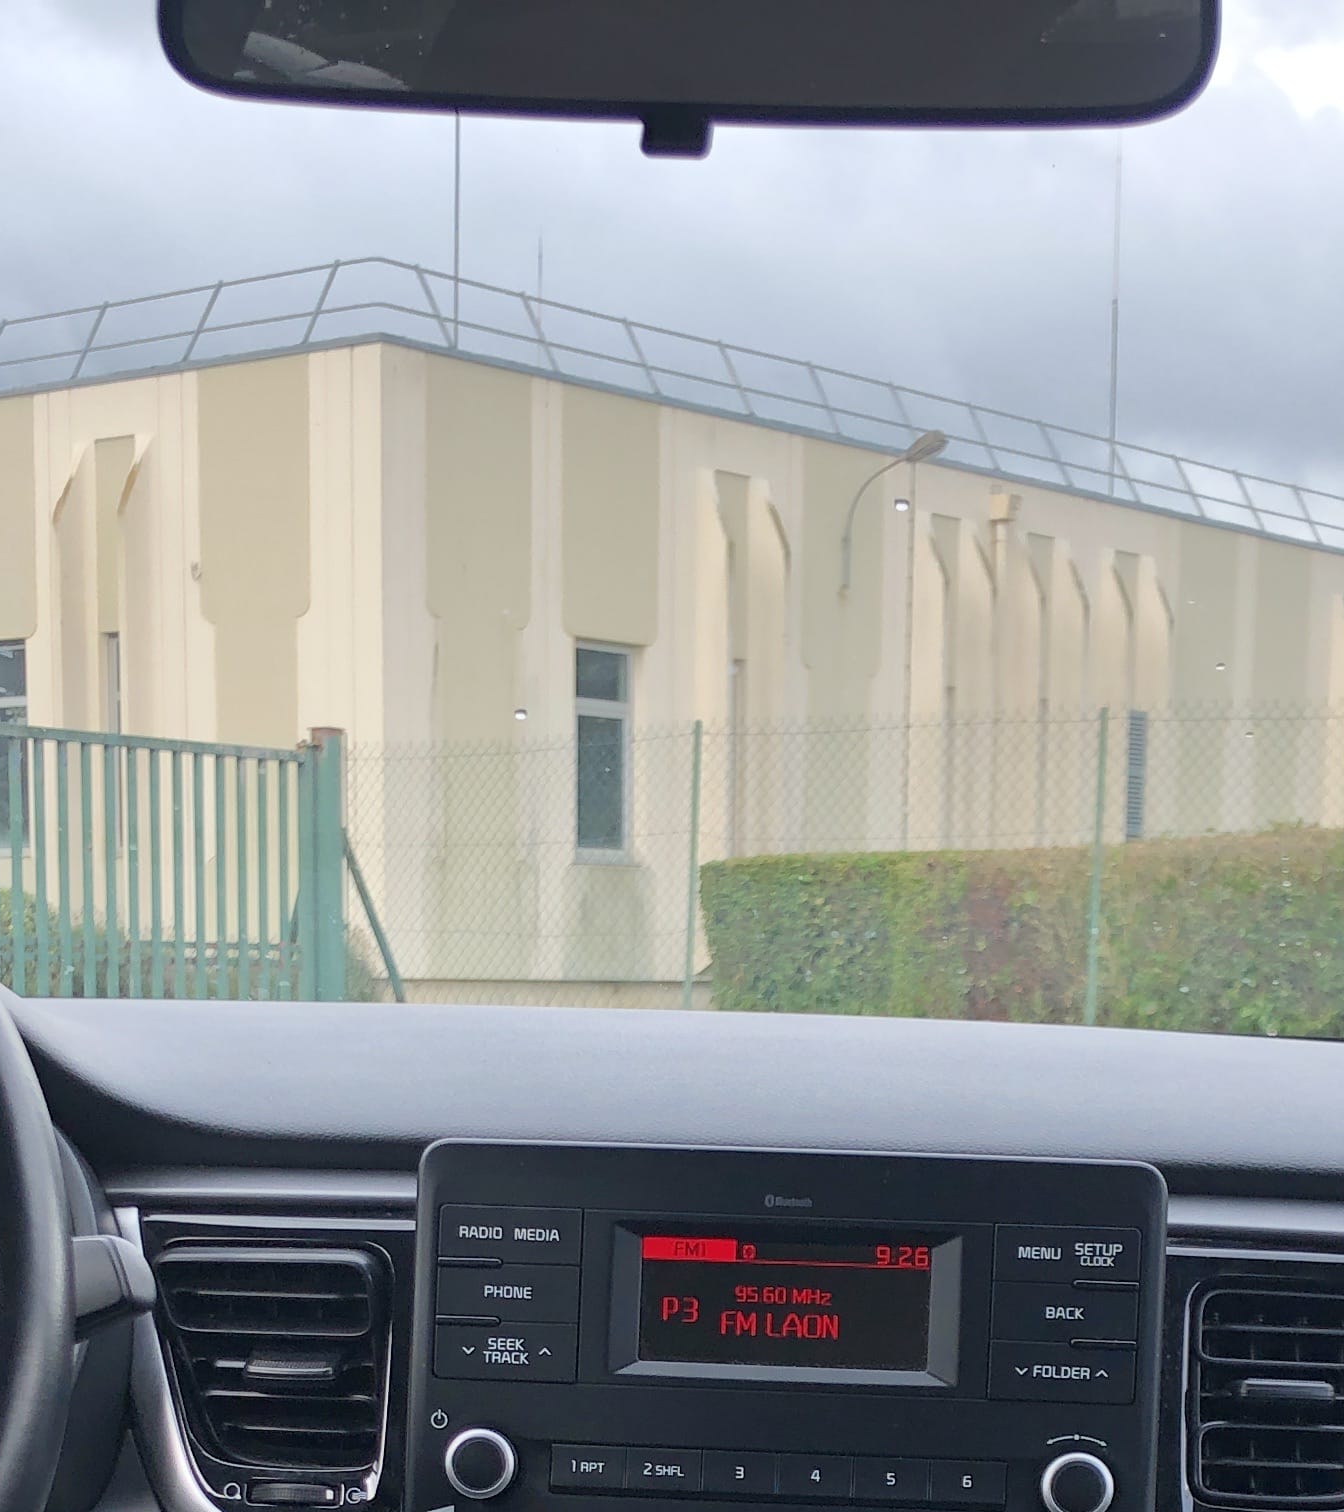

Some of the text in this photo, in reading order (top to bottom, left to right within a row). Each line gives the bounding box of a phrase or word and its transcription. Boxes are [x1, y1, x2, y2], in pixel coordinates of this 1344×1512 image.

[458, 1225, 503, 1240] RADIO
[513, 1227, 561, 1242] MEDIA
[1017, 1246, 1062, 1260] MENU
[1074, 1242, 1123, 1257] SETUP
[1080, 1256, 1115, 1267] CLOCK
[483, 1284, 533, 1299] PHONE
[791, 1288, 832, 1306] MHz
[661, 1296, 700, 1323] P3
[1045, 1306, 1085, 1320] BACK
[719, 1310, 840, 1341] FM LAON
[487, 1337, 525, 1351] SEEK
[482, 1350, 529, 1365] TRACK
[1032, 1364, 1091, 1380] FOLDER
[571, 1459, 606, 1474] 1 RPT
[643, 1462, 685, 1477] 2 SHFL
[735, 1466, 745, 1479] 3
[810, 1469, 821, 1482] 4
[886, 1472, 896, 1486] 5
[962, 1475, 973, 1488] 6
